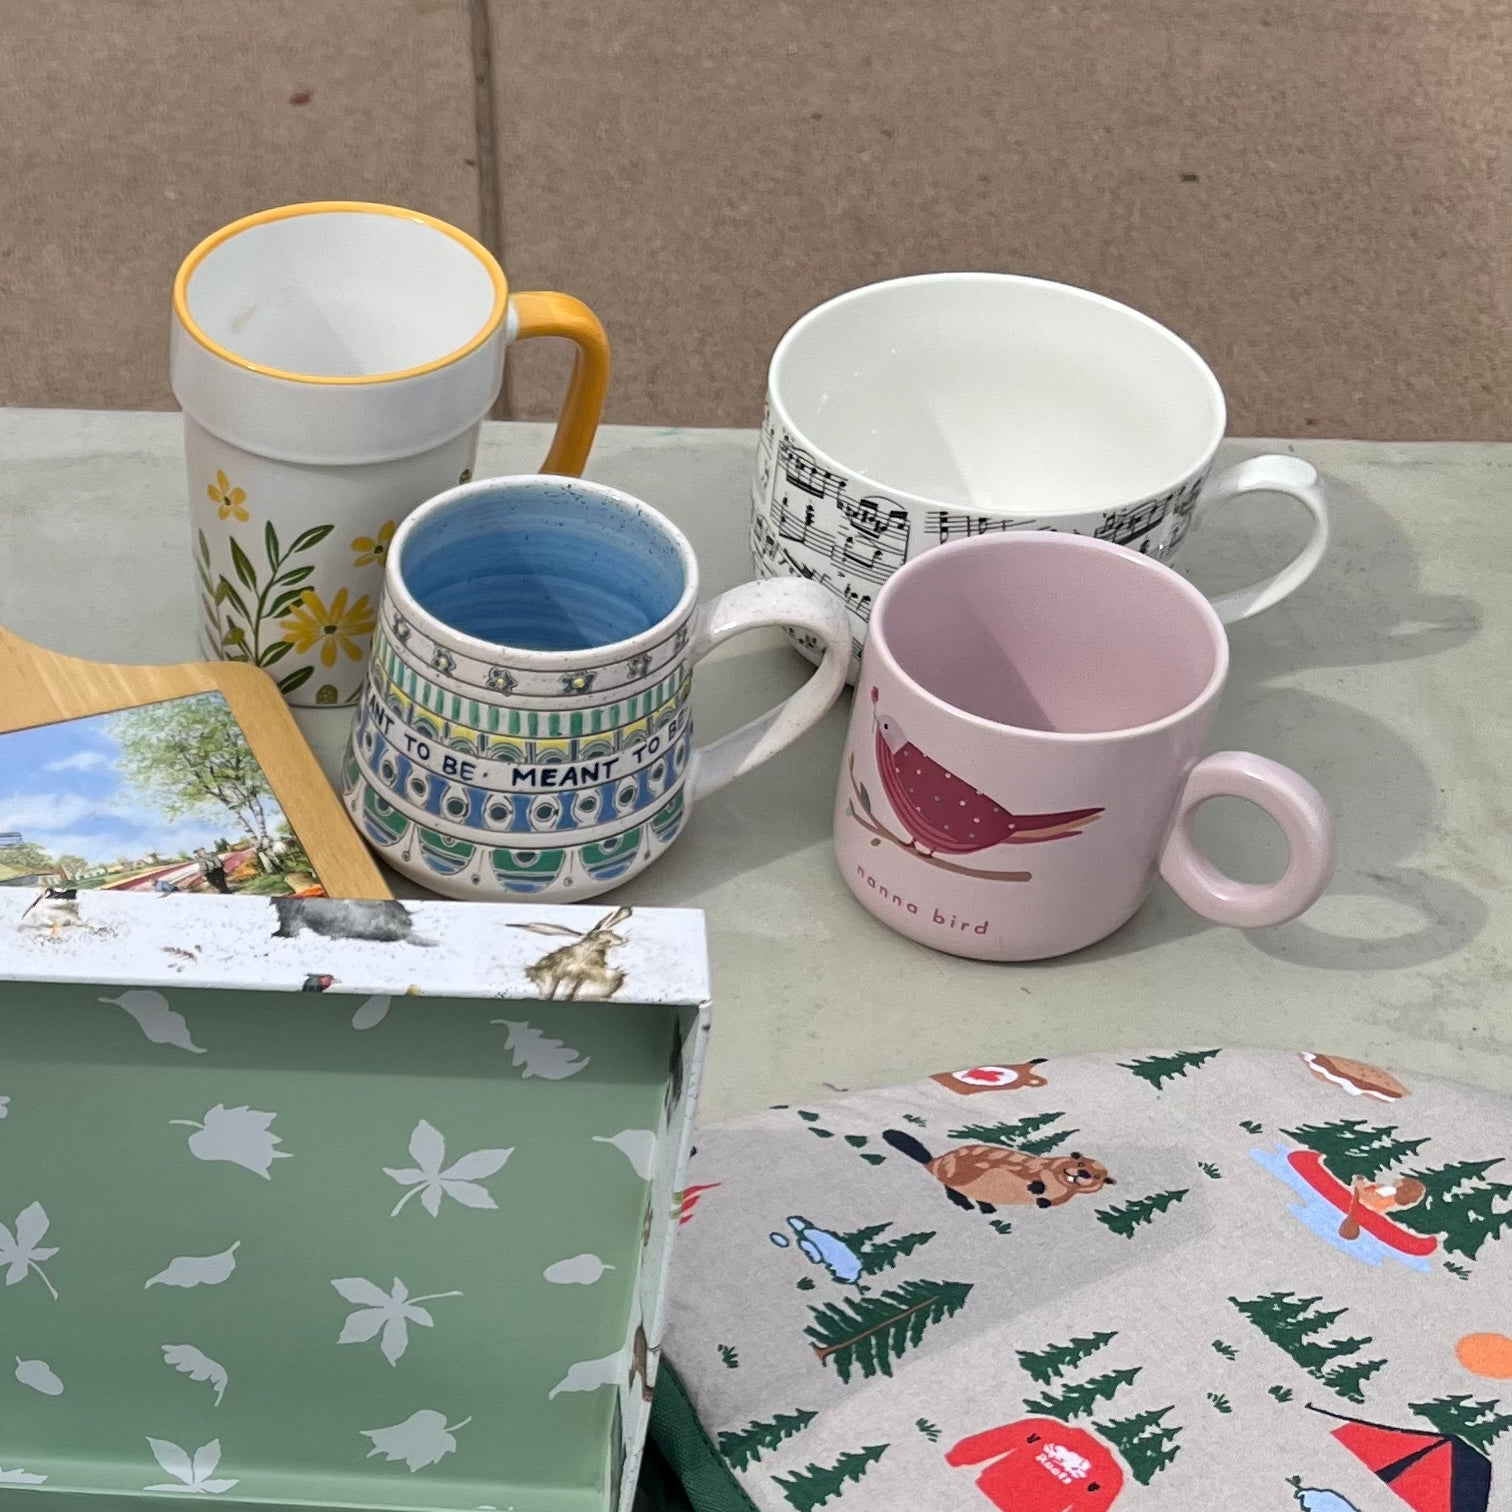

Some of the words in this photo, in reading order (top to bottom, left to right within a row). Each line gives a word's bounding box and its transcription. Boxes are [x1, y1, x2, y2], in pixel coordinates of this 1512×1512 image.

[403, 733, 430, 760] TO
[512, 759, 619, 787] MEANT
[632, 736, 661, 764] TO
[856, 864, 919, 915] nanna
[932, 908, 989, 936] bird
